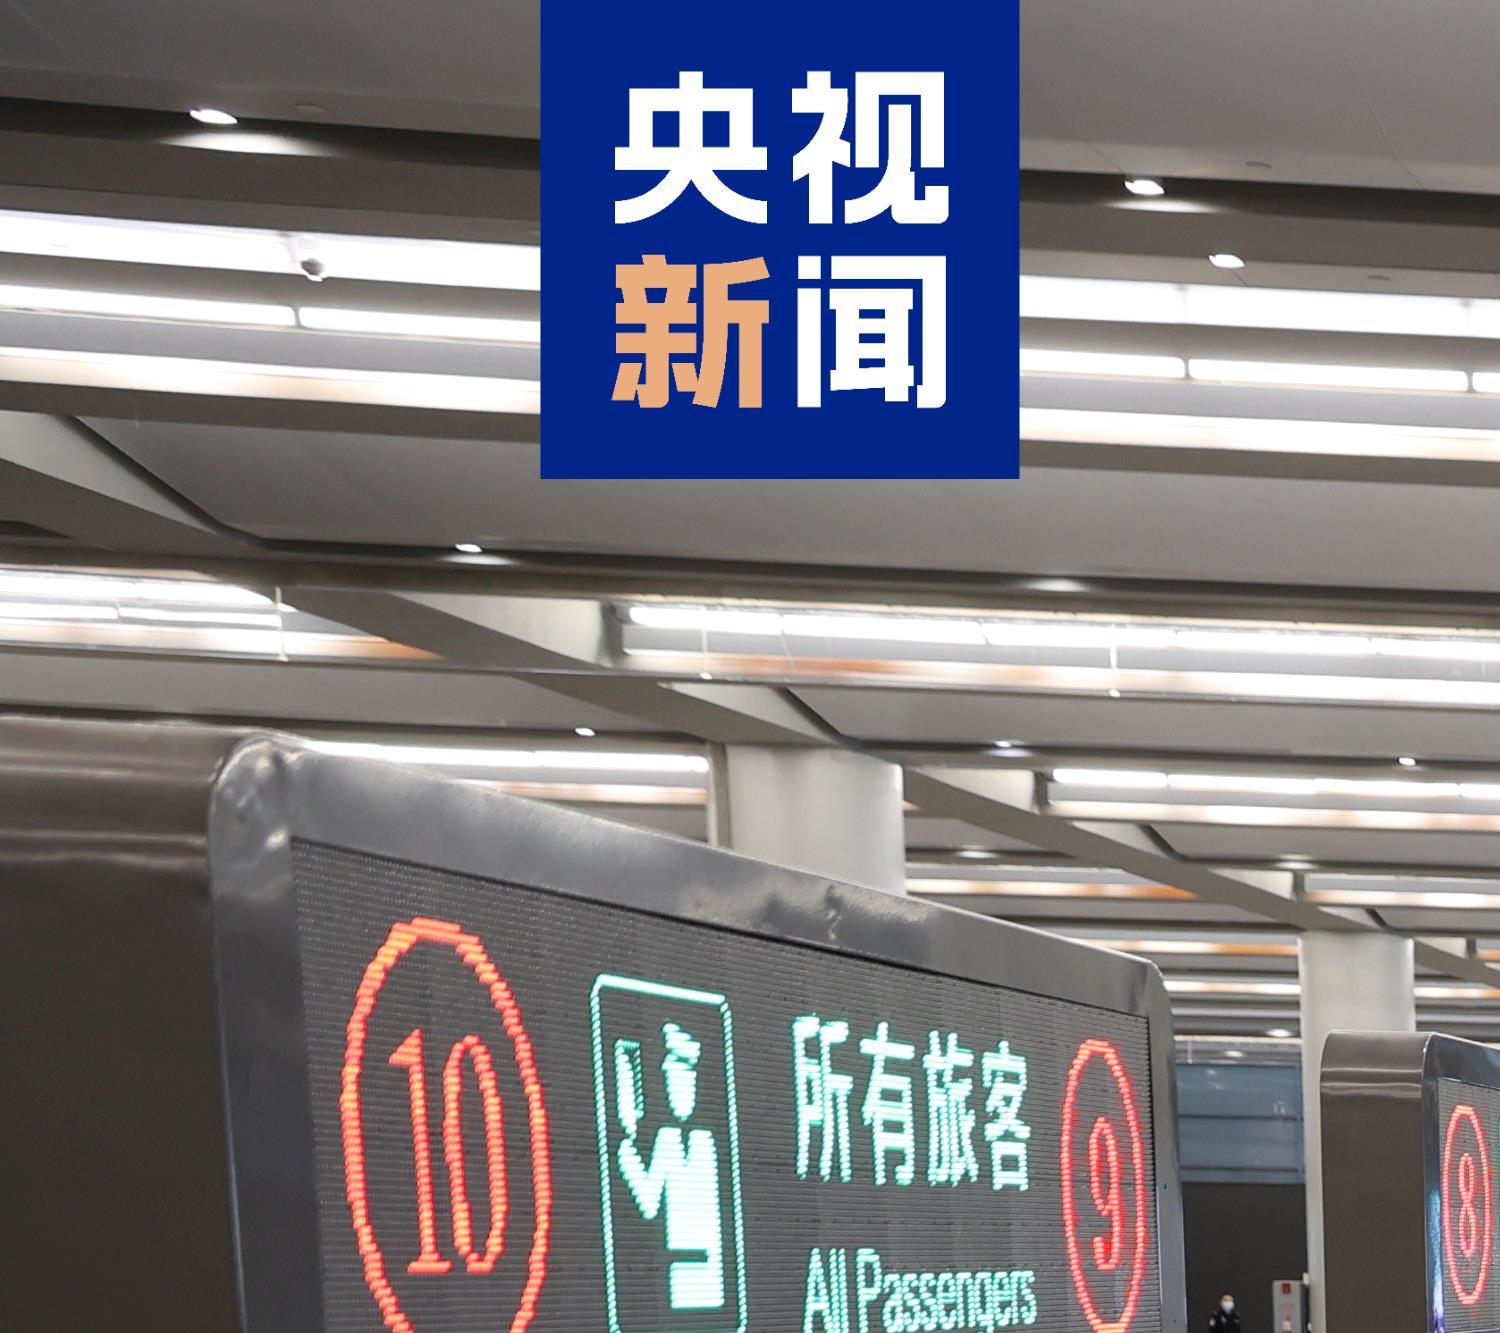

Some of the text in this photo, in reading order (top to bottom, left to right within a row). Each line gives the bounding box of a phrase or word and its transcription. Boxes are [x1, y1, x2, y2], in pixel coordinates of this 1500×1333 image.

[389, 1028, 507, 1274] 10
[794, 1013, 1029, 1191] 所有旅客
[1088, 1116, 1120, 1271] 9
[1458, 1152, 1478, 1258] 8
